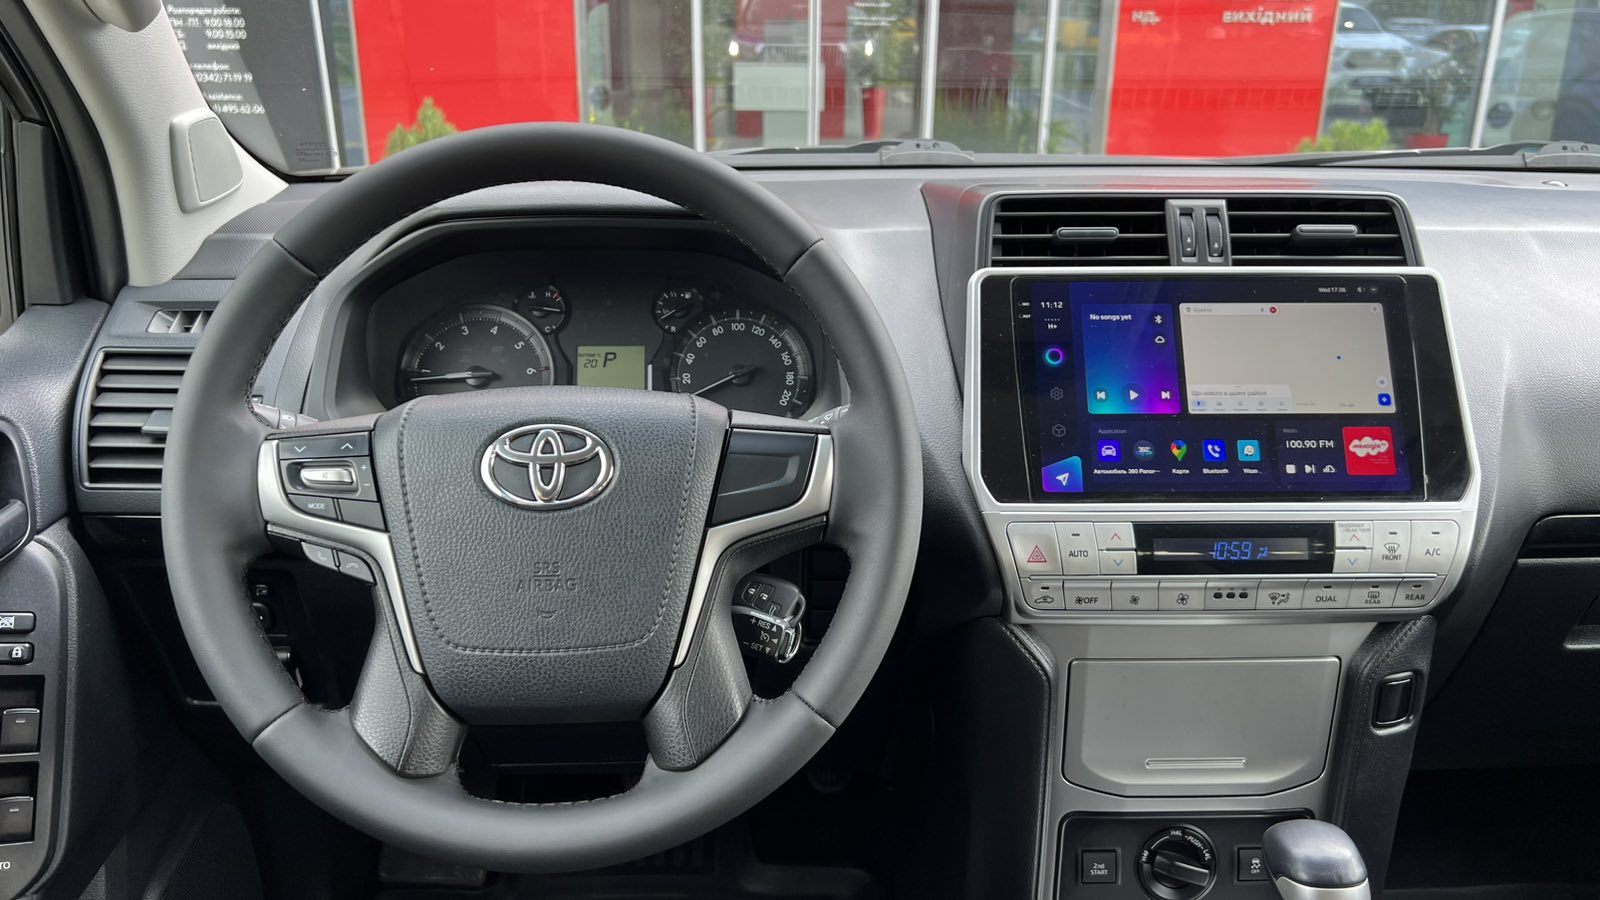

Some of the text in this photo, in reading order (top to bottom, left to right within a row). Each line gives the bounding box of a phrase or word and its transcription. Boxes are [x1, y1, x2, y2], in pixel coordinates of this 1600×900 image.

[1040, 301, 1063, 309] 11:12
[461, 325, 470, 335] 3
[489, 325, 499, 335] 4
[711, 326, 724, 336] 80
[731, 323, 745, 331] 100
[751, 325, 765, 336] 120
[434, 341, 446, 351] 2
[514, 340, 525, 350] 5
[695, 336, 707, 348] 60
[768, 335, 782, 348] 140
[603, 352, 617, 368] P
[685, 352, 696, 365] 40
[781, 351, 792, 366] 160
[583, 359, 598, 369] 20
[526, 367, 537, 375] 6
[682, 372, 692, 385] 20
[785, 371, 794, 385] 180
[779, 389, 792, 406] 200
[1286, 440, 1334, 448] 100.90 FM
[1068, 550, 1089, 558] AUTO
[1213, 541, 1252, 560] 10:59
[1424, 548, 1441, 556] A/C
[757, 619, 771, 629] RES
[750, 642, 763, 652] SET
